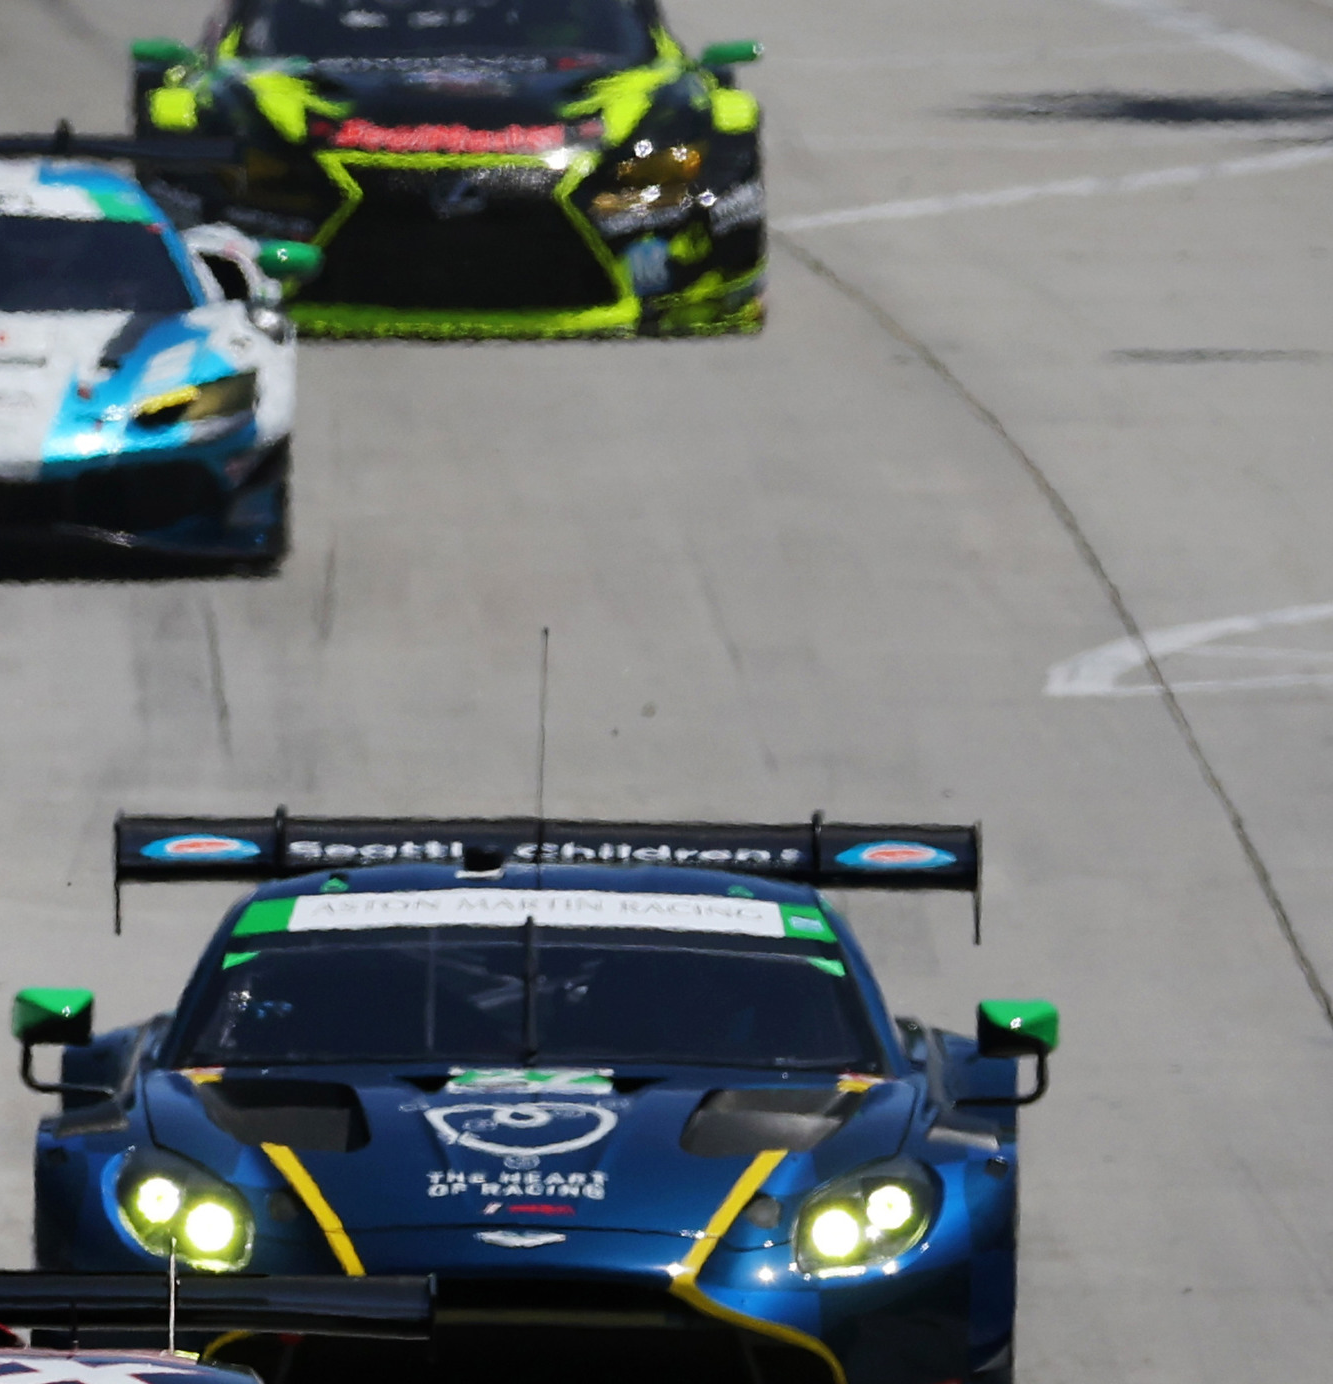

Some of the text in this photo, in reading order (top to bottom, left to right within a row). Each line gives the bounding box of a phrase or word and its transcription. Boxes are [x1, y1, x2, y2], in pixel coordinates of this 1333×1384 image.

[288, 840, 464, 859] Seattl
[311, 894, 764, 922] ASTON MARTIN RACING
[427, 1171, 609, 1185] THE HEART
[428, 1184, 605, 1200] OF RACING
